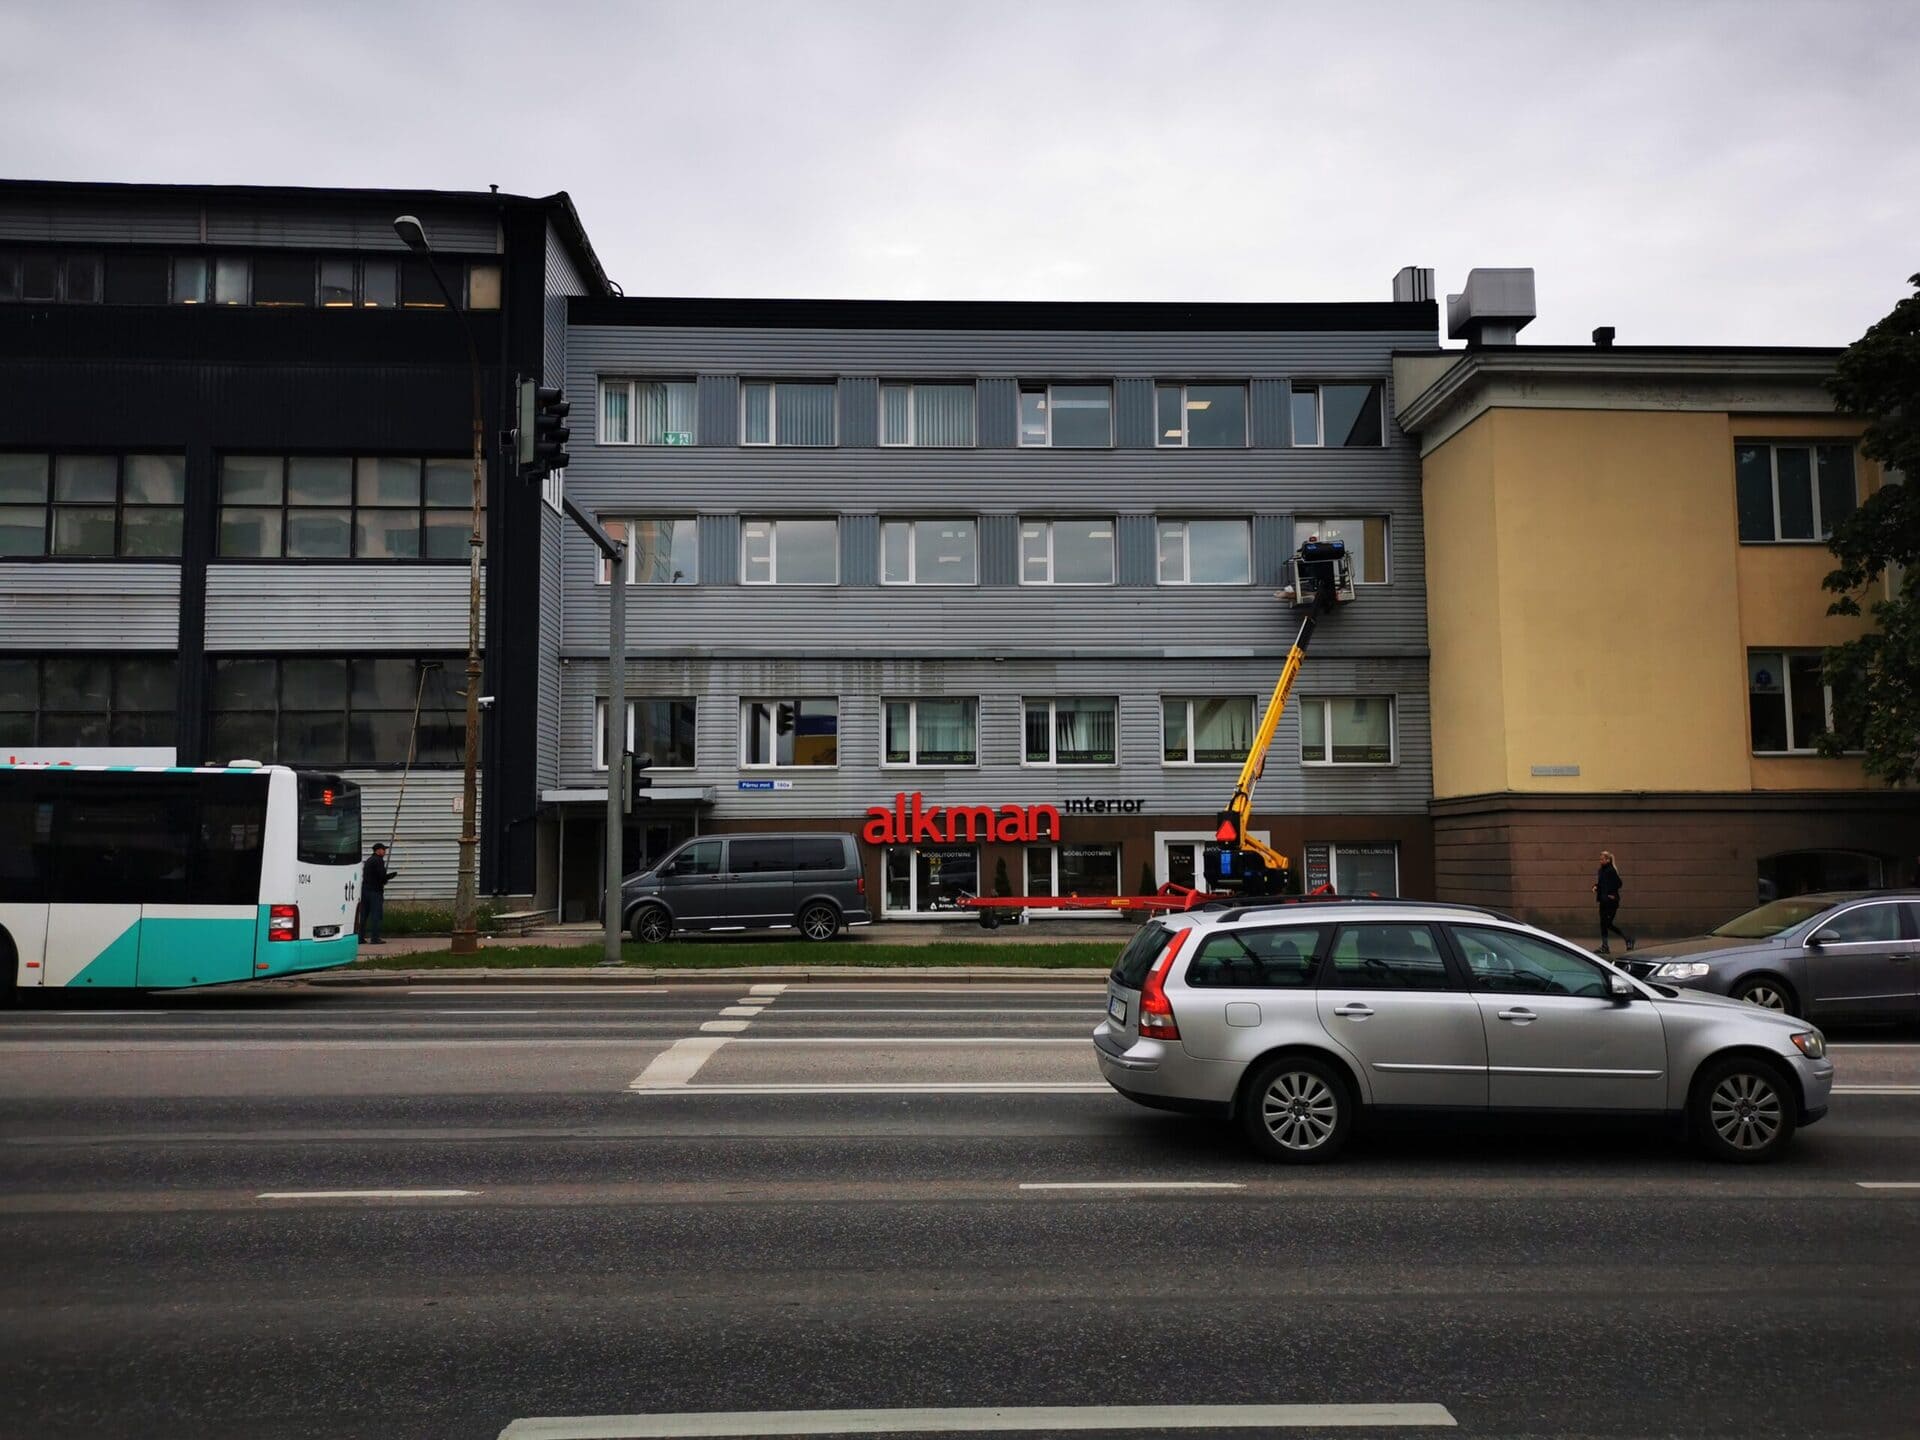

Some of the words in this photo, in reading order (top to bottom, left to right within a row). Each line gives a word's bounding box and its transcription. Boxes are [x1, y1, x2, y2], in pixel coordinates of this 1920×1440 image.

[863, 791, 1060, 844] alkman
[1064, 797, 1145, 812] interior
[298, 873, 311, 885] 1014
